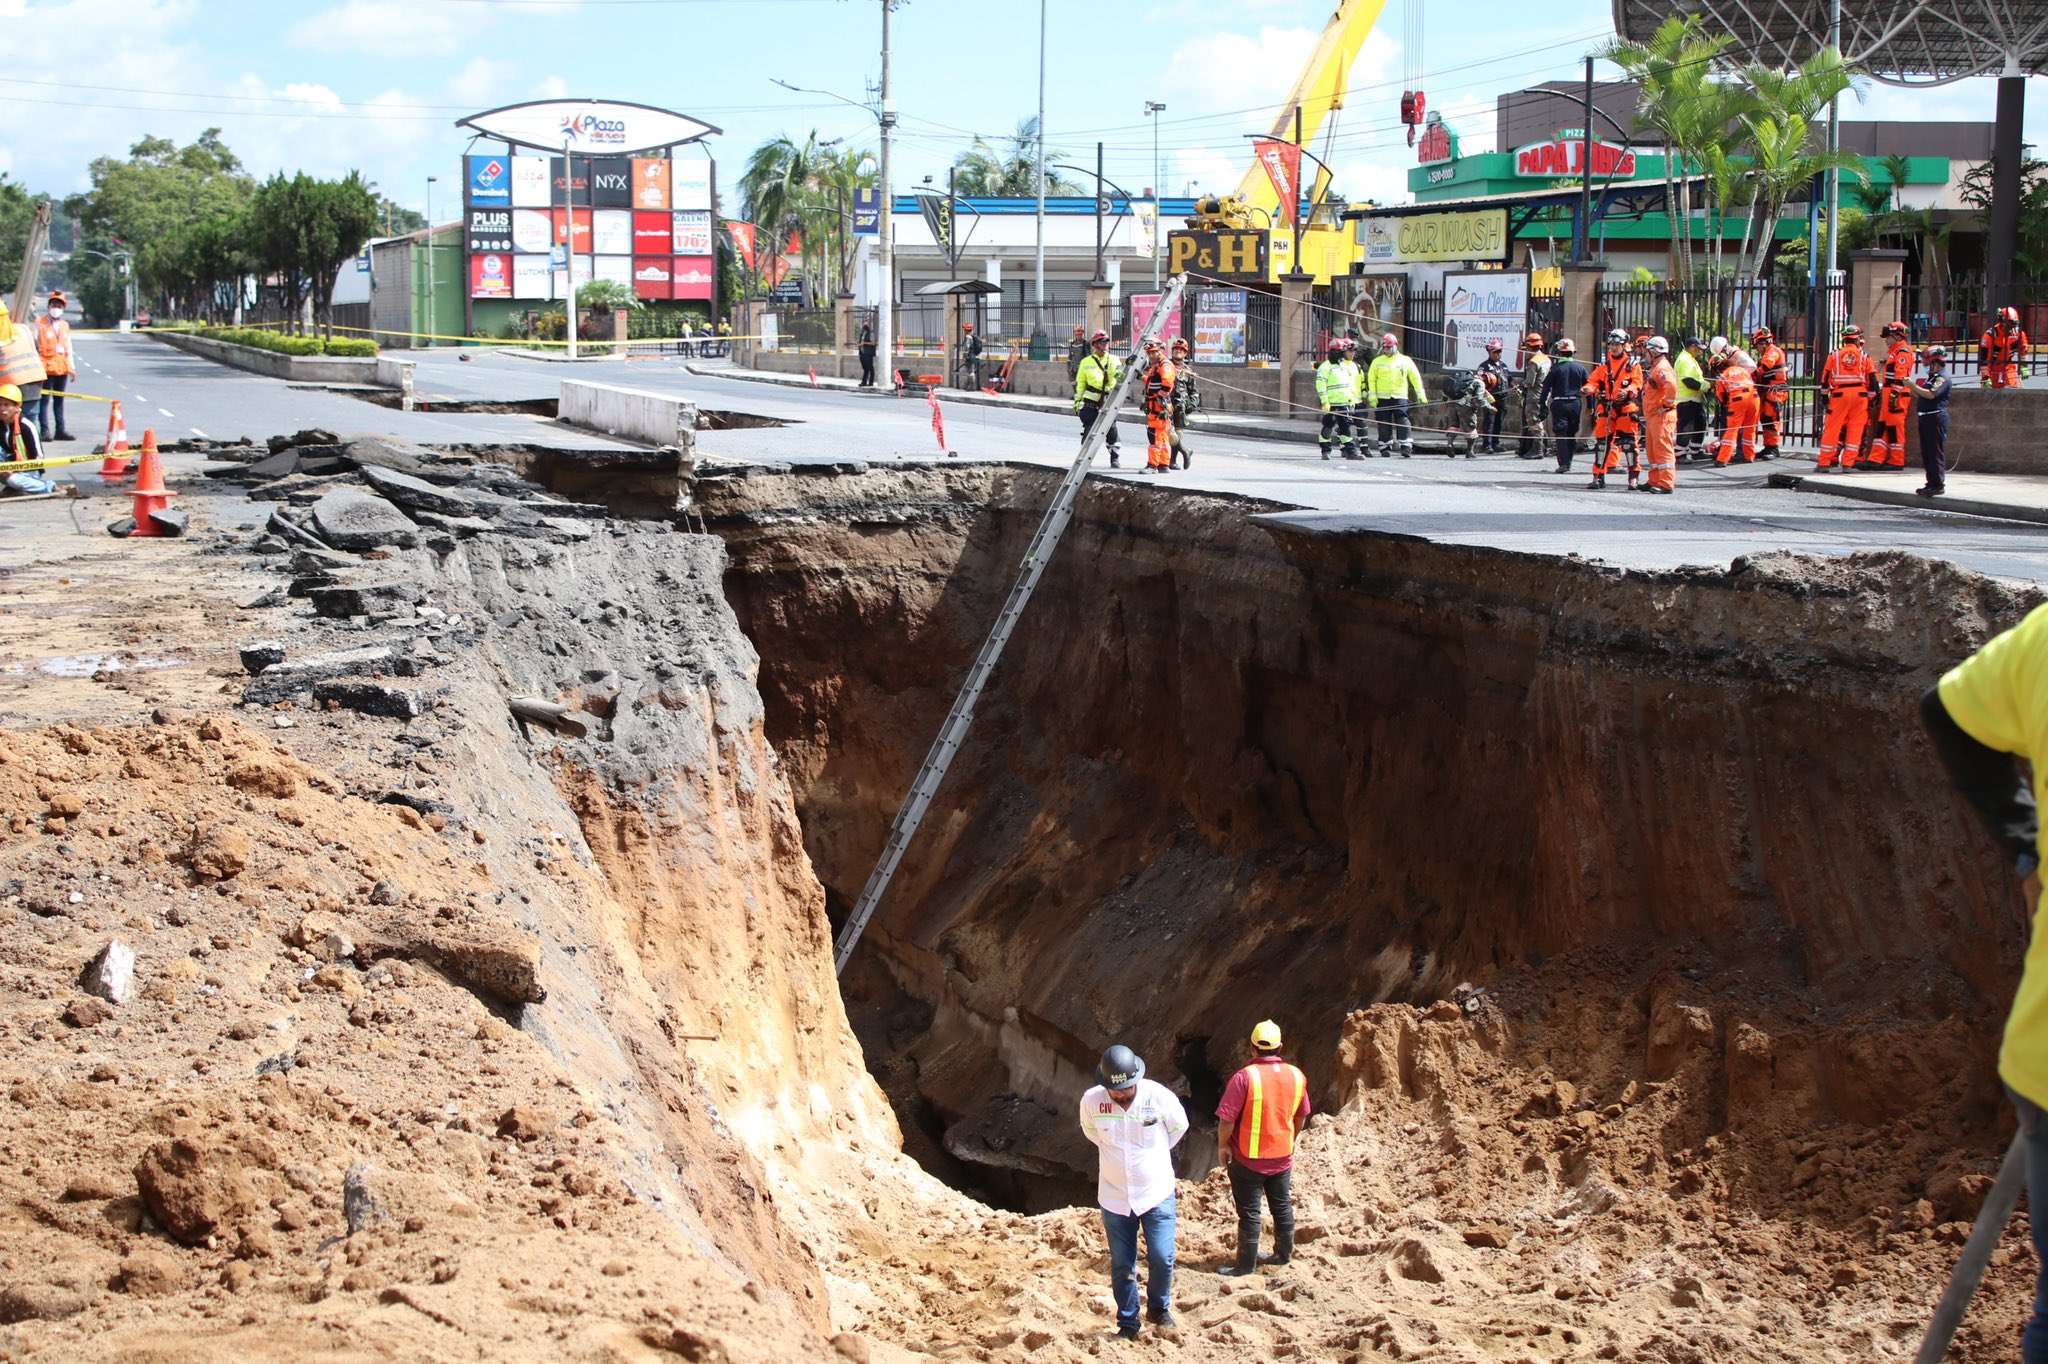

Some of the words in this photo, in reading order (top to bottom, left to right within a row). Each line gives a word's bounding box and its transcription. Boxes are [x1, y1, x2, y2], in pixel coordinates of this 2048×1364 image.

[584, 115, 625, 131] Plaza
[1566, 128, 1585, 137] PIZZ
[1520, 141, 1568, 173] PAPA
[596, 174, 627, 190] NYX
[473, 213, 509, 225] PLUS
[1400, 222, 1438, 254] CAR
[1441, 217, 1501, 252] WASH
[1383, 281, 1404, 303] NYX
[1487, 291, 1519, 313] Cleaner
